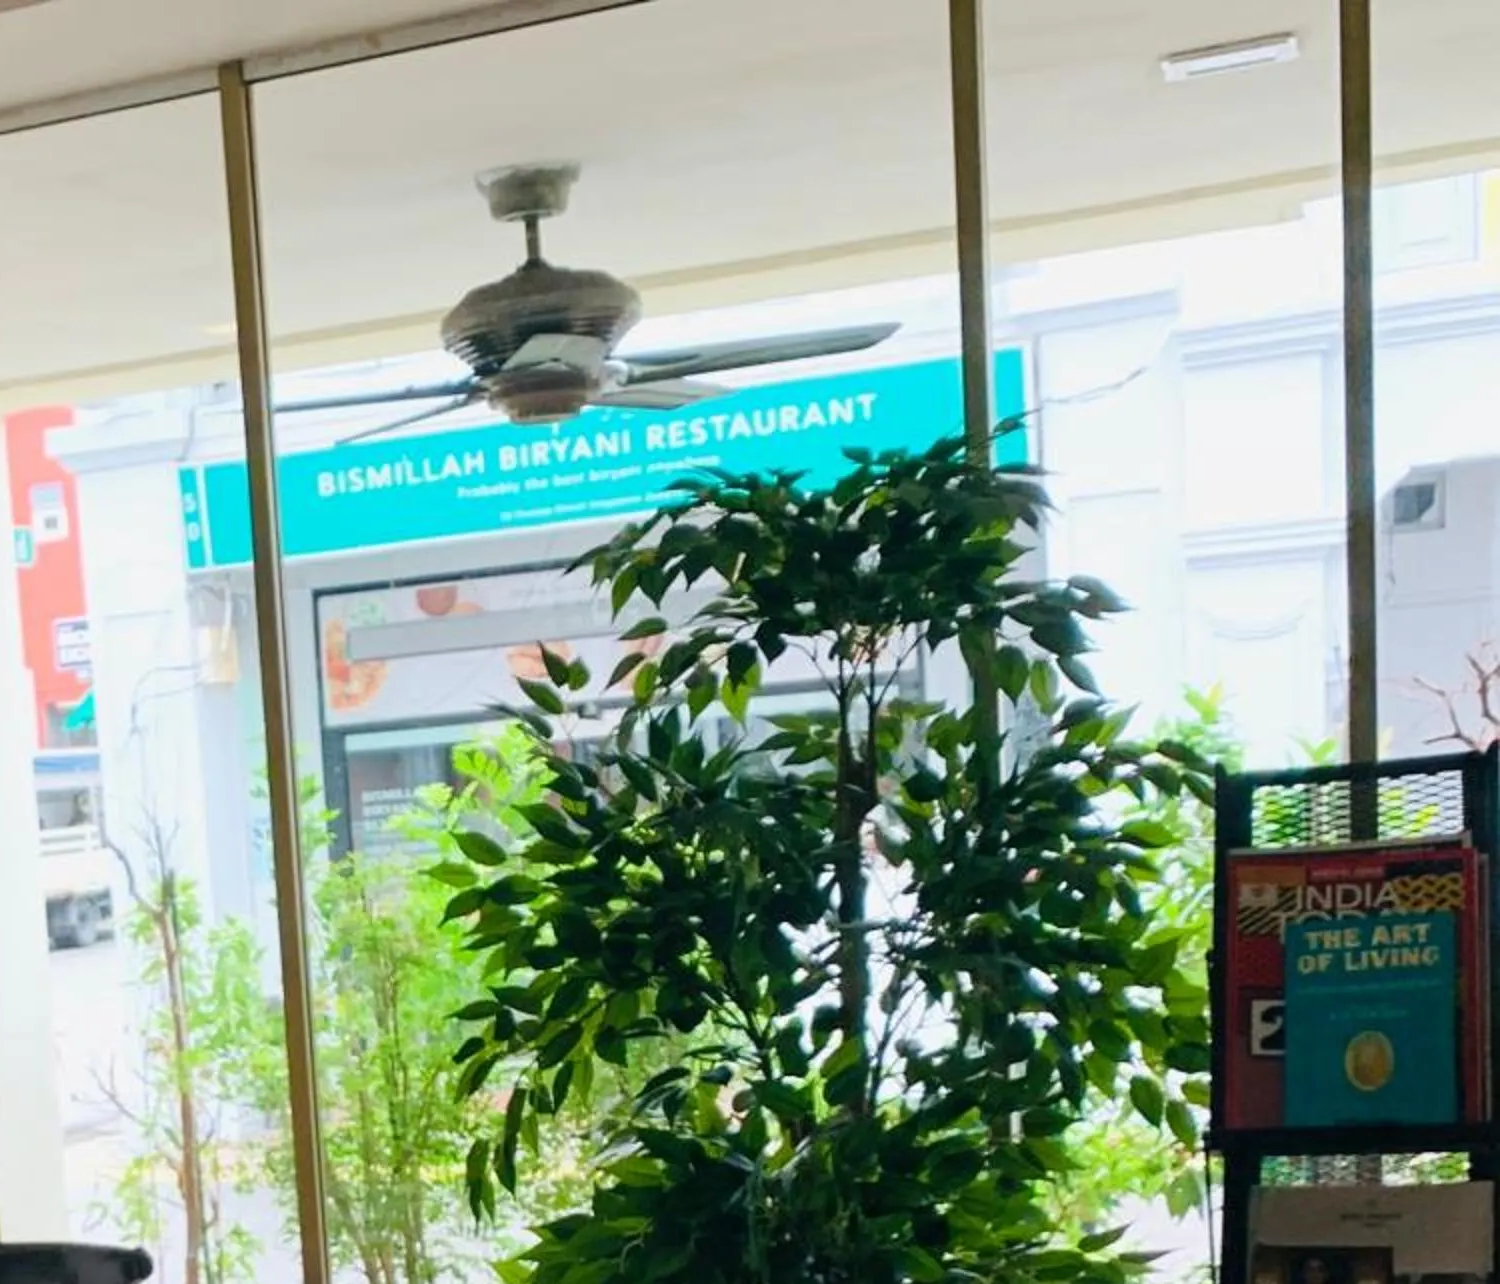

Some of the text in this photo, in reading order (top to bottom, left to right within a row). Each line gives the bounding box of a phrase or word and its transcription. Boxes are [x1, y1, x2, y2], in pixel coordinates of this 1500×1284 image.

[316, 393, 878, 498] BISMILLAH BIRYANI RESTAURANT
[1296, 881, 1399, 912] INDIA
[1304, 927, 1361, 951] THE
[1371, 922, 1432, 947] ART
[1297, 945, 1441, 975] OF LIVING
